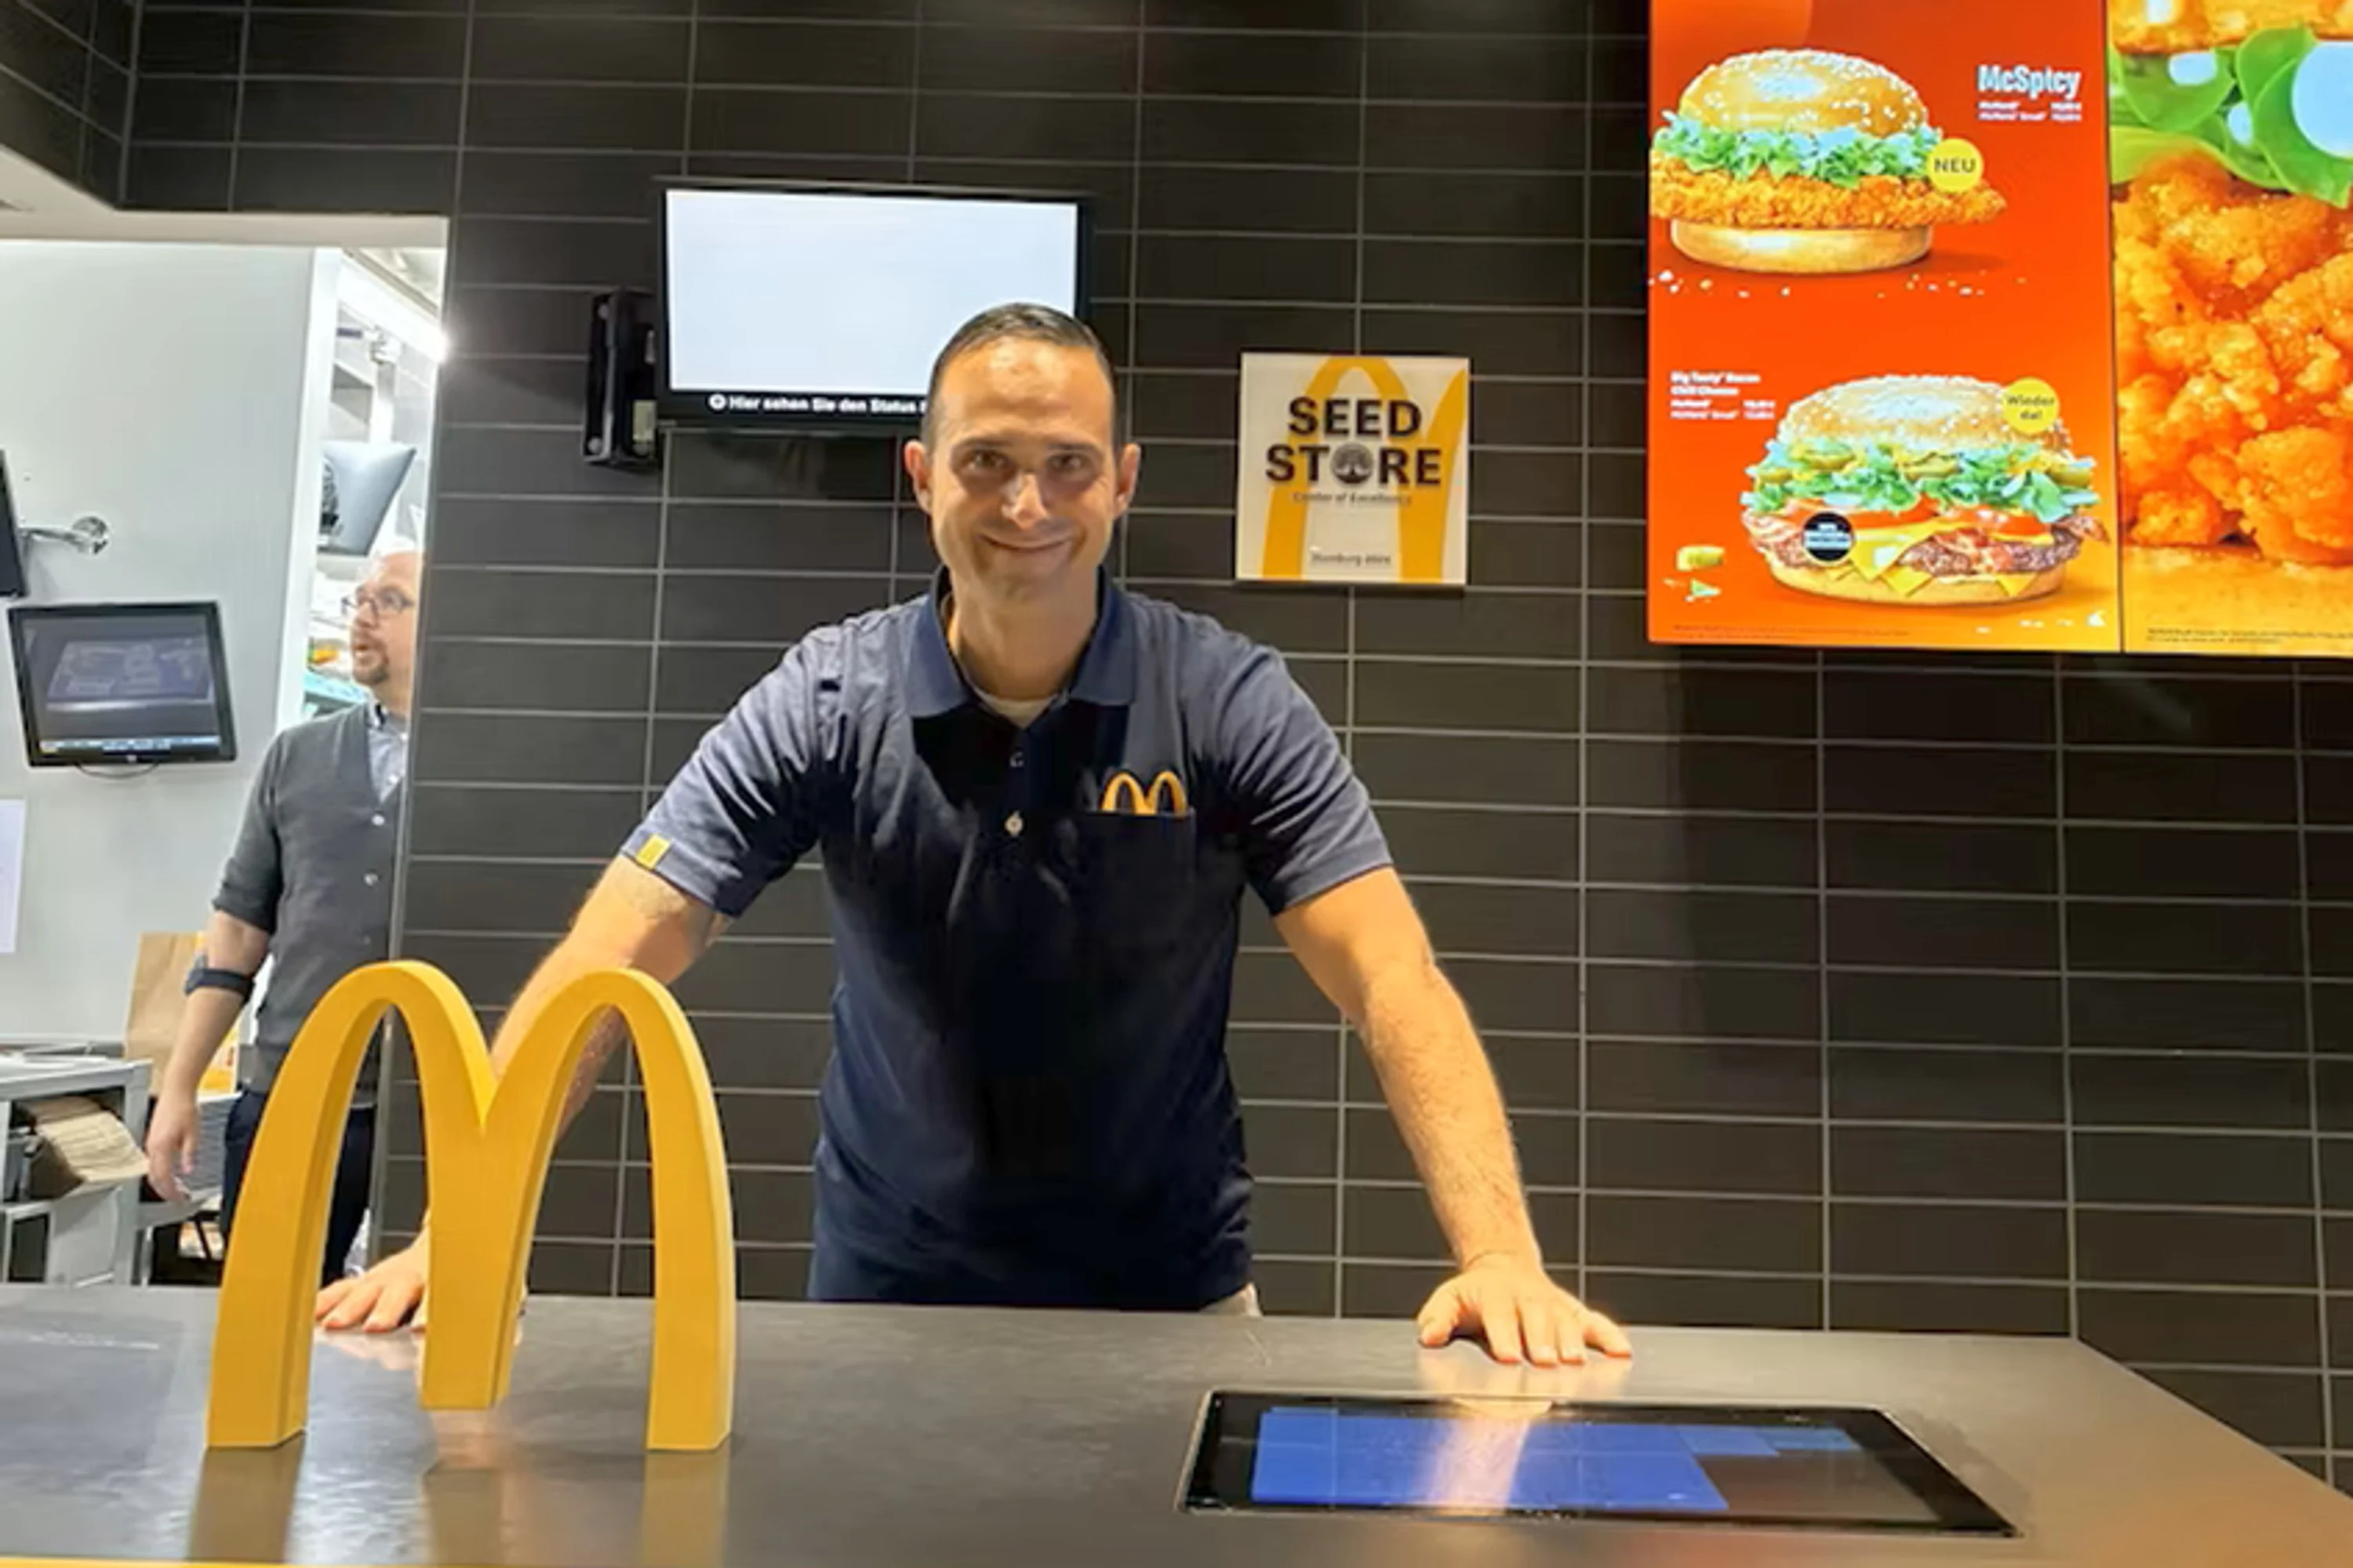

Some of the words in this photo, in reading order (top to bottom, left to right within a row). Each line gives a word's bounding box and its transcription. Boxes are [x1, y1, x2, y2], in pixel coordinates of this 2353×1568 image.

[1977, 64, 2082, 100] McSpicy
[1933, 158, 1977, 173] NEU
[729, 395, 760, 410] Hier
[763, 397, 809, 411] sehen
[813, 397, 836, 412] Sie
[838, 398, 867, 413] den
[1287, 396, 1422, 437] SEED
[1264, 442, 1442, 486] STORE
[1335, 492, 1347, 503] of
